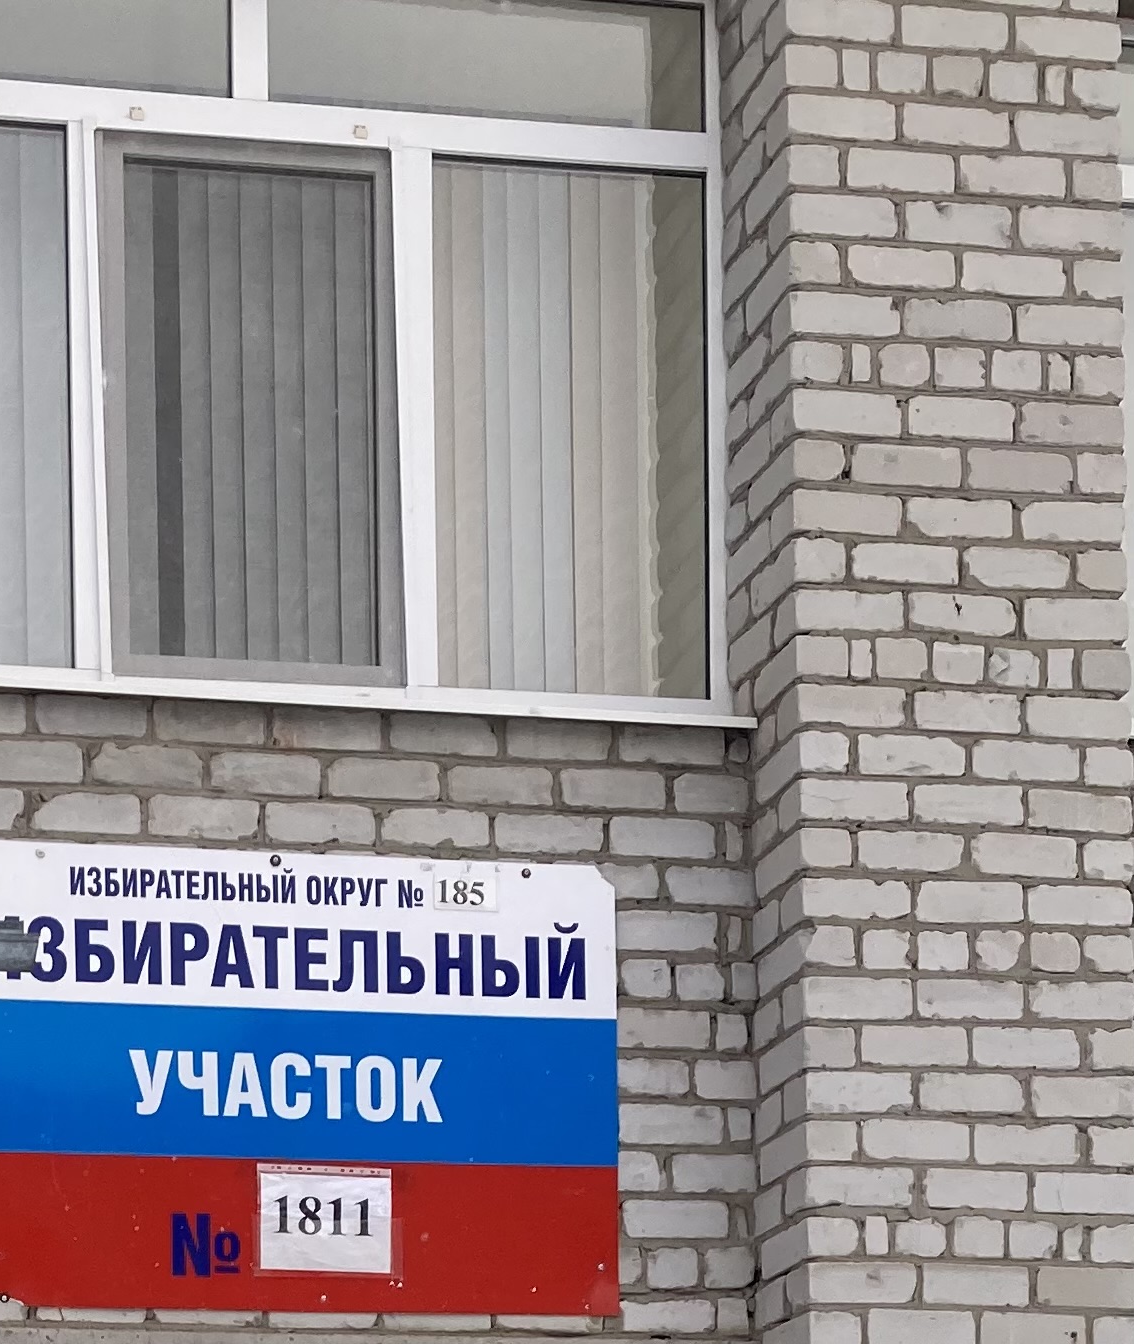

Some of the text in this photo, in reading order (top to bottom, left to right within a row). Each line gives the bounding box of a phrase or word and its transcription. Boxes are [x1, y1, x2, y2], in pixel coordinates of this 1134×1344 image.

[69, 865, 485, 909] ИЗБИРАТЕЛЬНЫЙ ОКРУГ № 185
[128, 1048, 443, 1123] УЧАСТОК
[171, 1194, 373, 1277] № 1811
